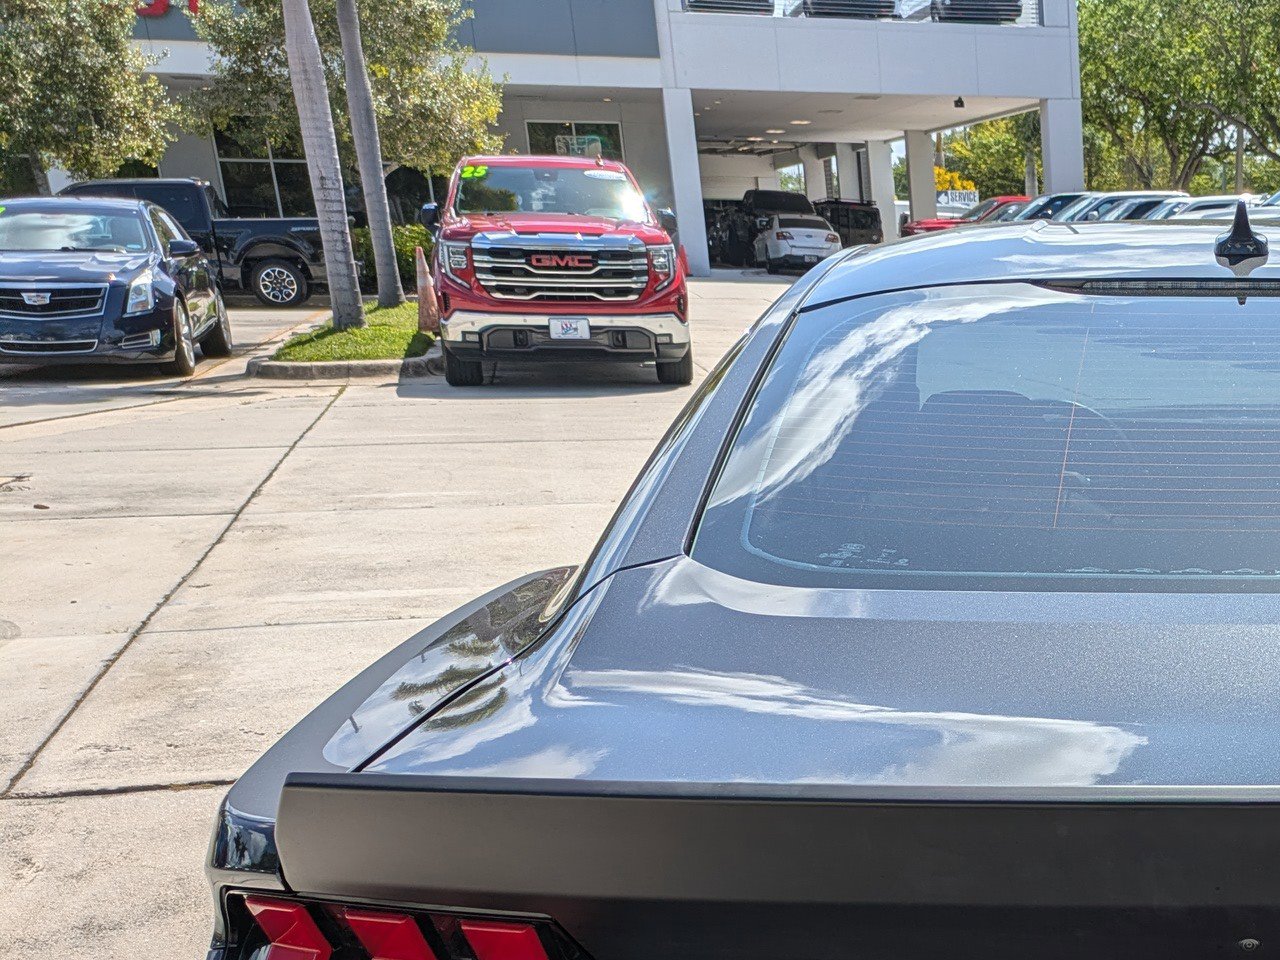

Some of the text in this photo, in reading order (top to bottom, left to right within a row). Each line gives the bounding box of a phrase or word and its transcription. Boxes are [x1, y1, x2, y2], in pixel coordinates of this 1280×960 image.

[461, 165, 489, 179] 25
[950, 191, 977, 203] SERVICE
[531, 254, 593, 267] GMC
